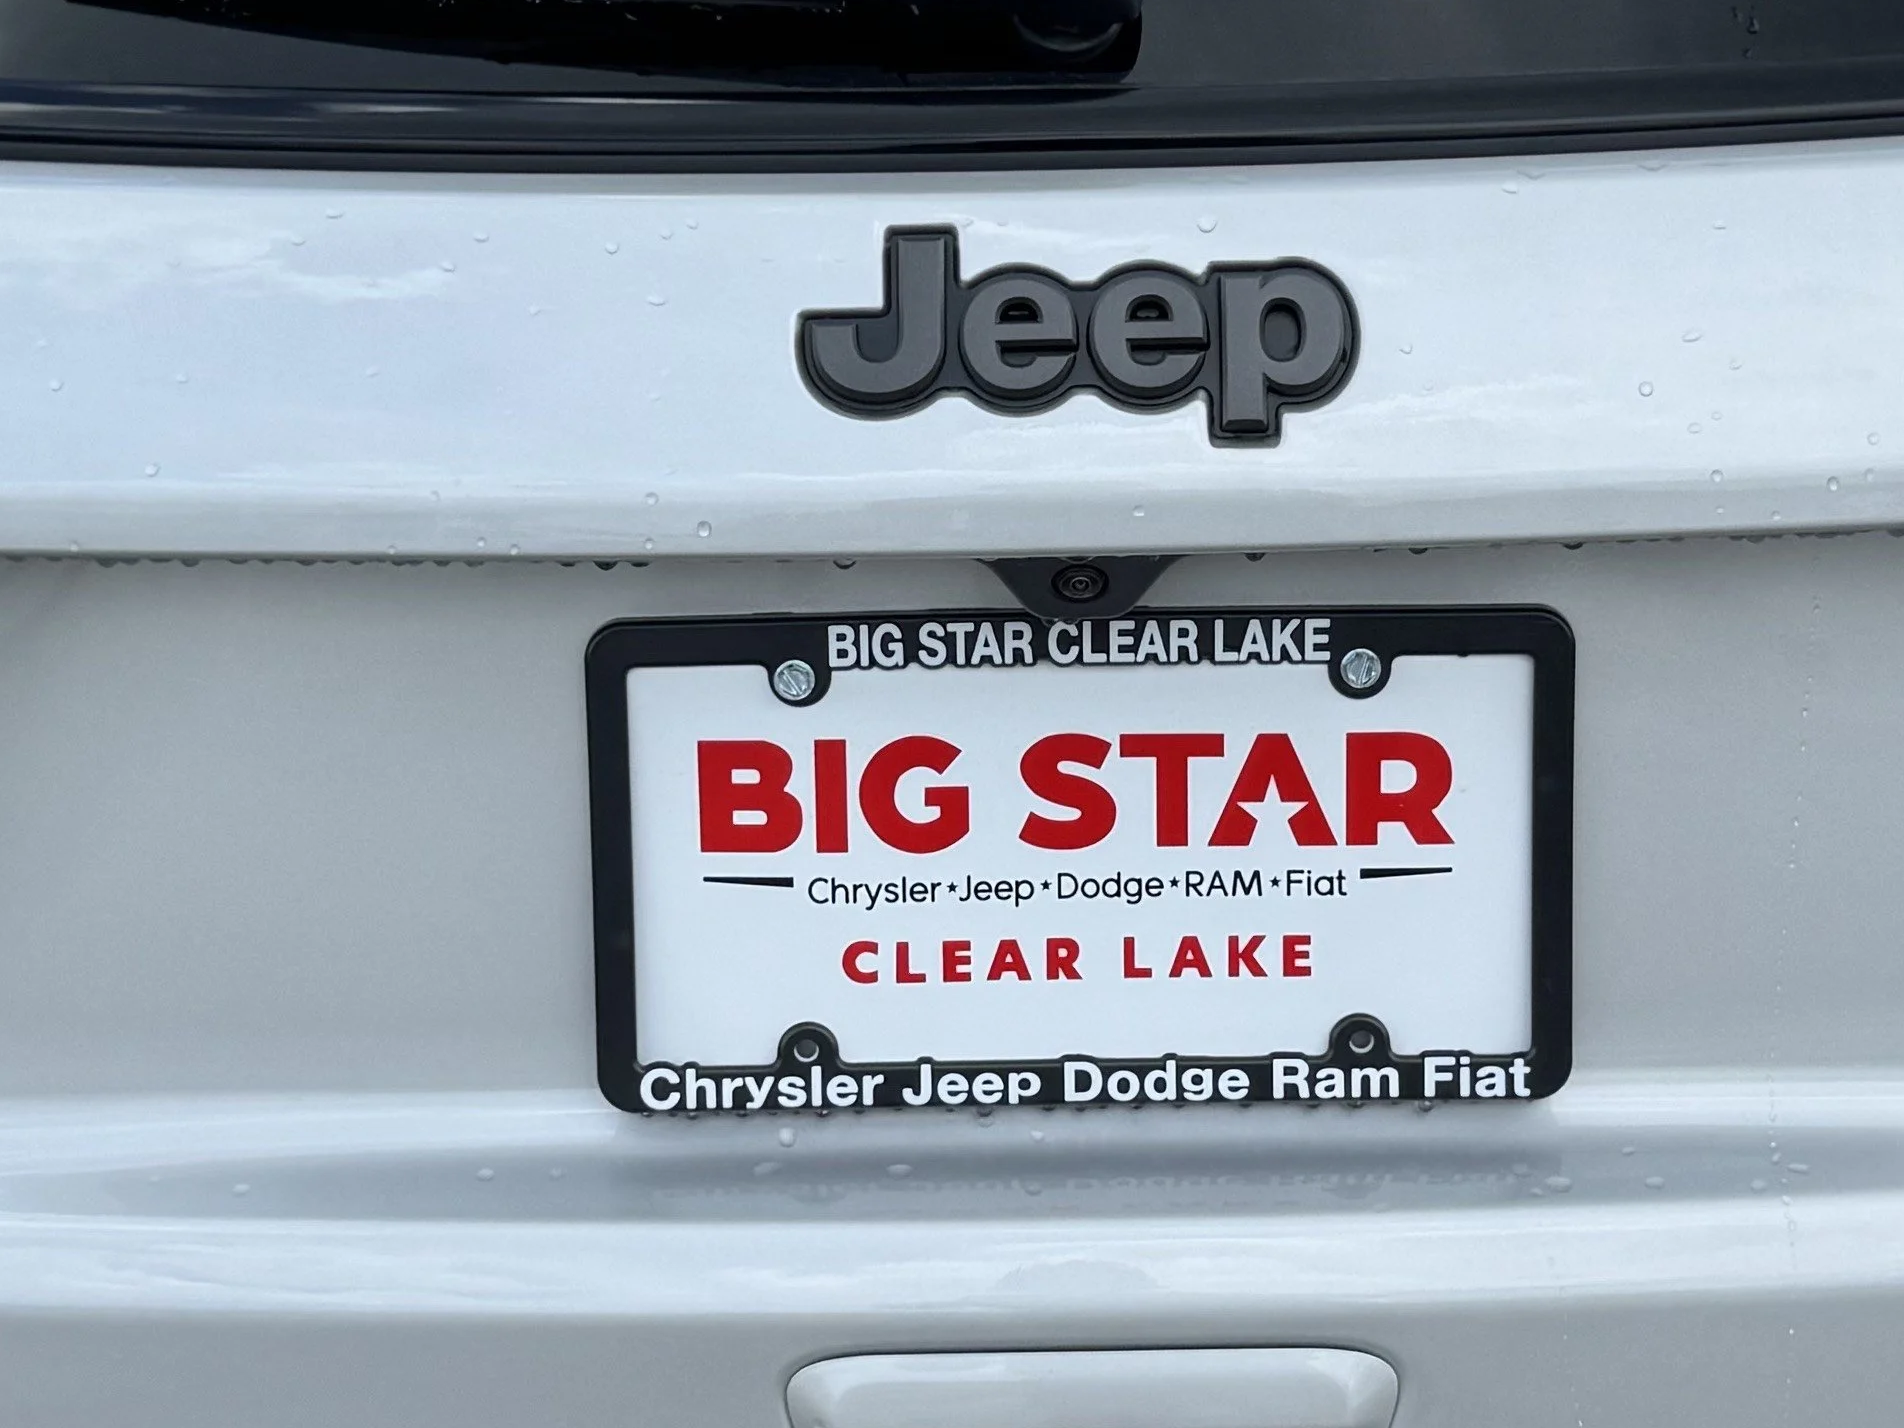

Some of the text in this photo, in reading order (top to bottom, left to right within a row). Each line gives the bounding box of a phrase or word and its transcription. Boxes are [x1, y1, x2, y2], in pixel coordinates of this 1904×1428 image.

[796, 224, 1361, 448] Jeep
[827, 618, 1332, 668] BIG STAR CLEAR LAKE
[697, 732, 1454, 855] BIG STAR
[807, 868, 1349, 911] Chrysler Jeep Dodge RAM Fiat
[841, 935, 1313, 984] CLEAR LAKE
[639, 1055, 1532, 1111] Chrysler Jeep Dodge Ram Fiat
